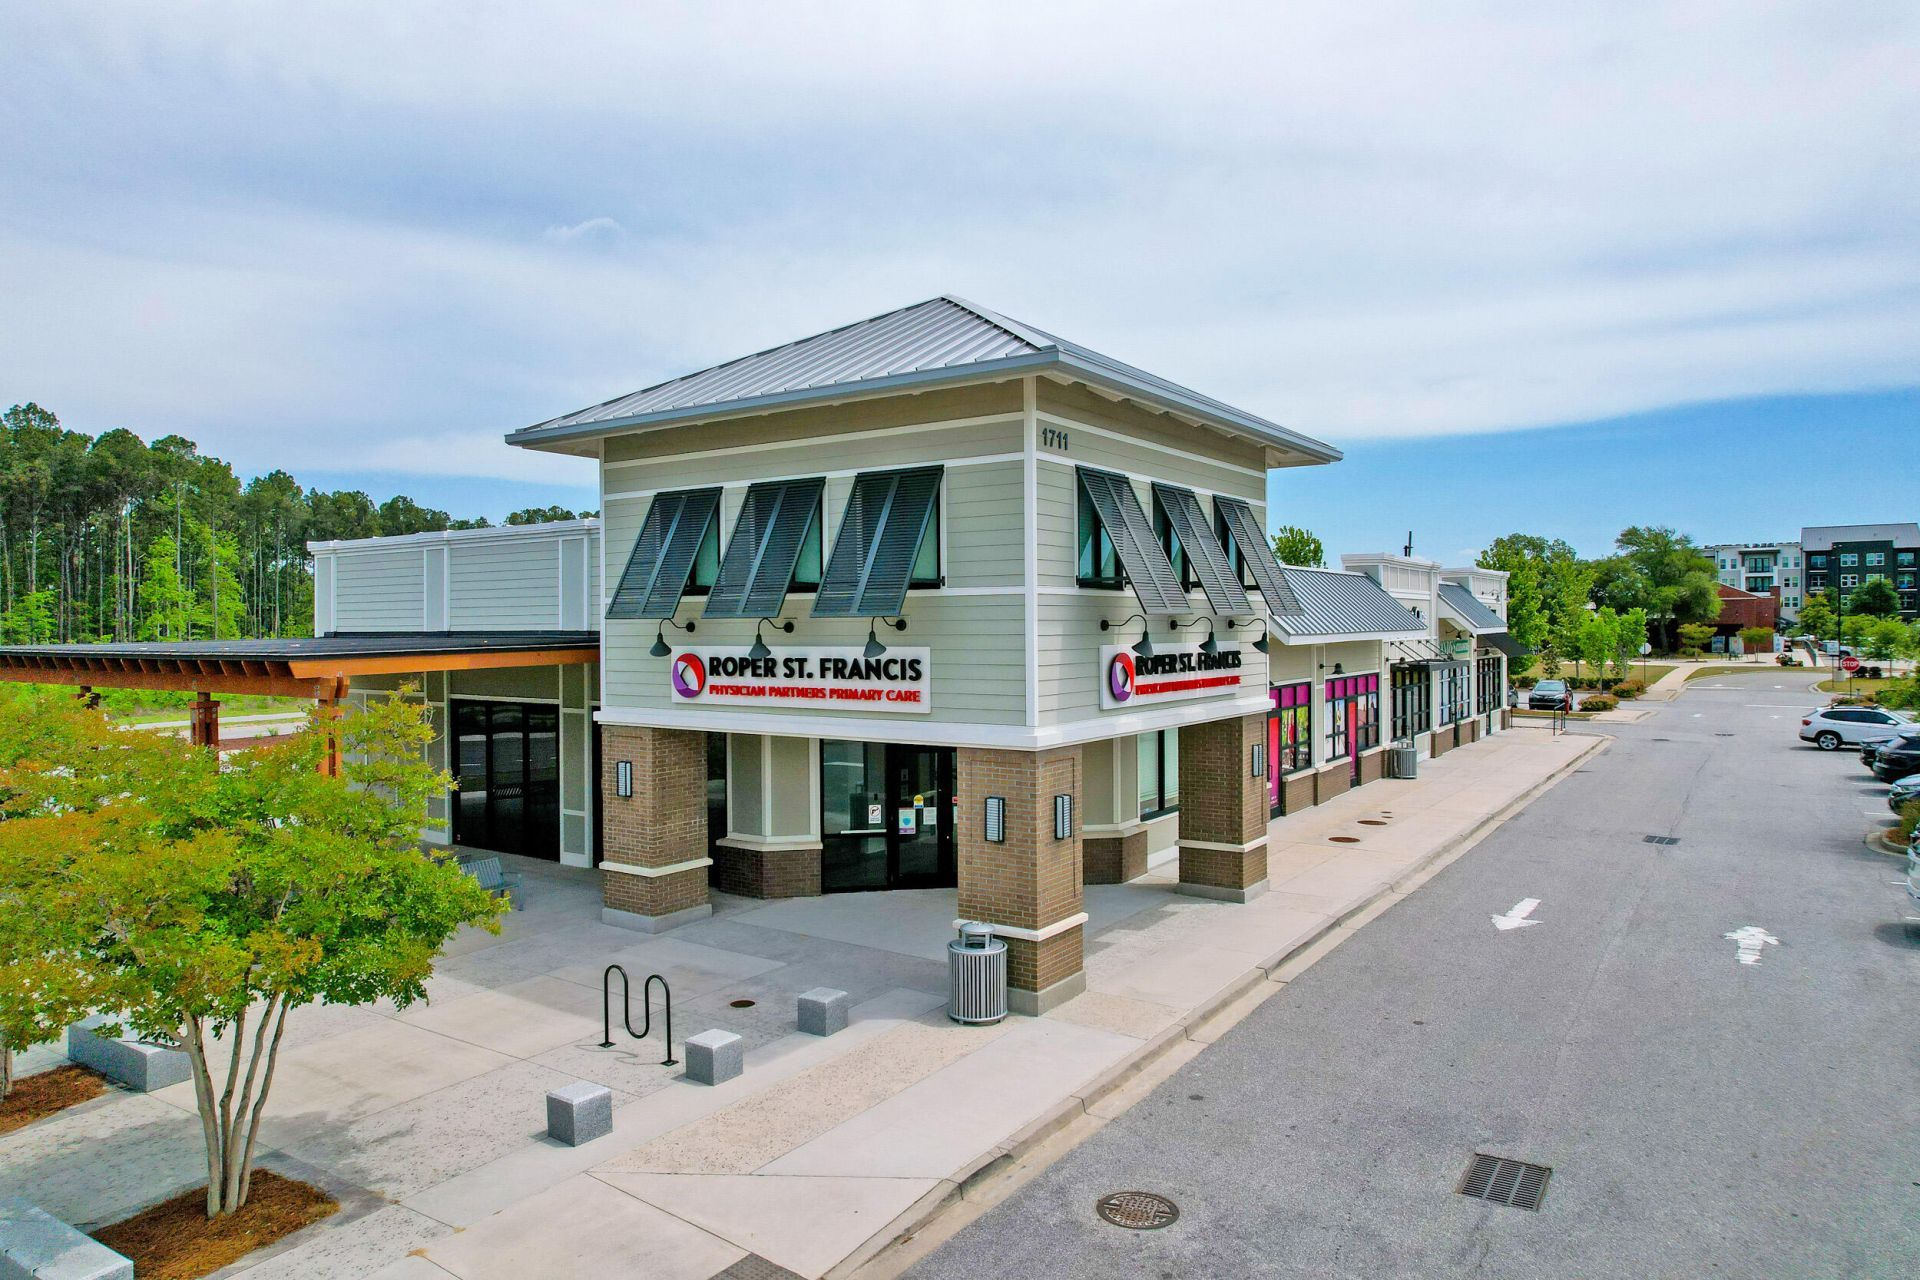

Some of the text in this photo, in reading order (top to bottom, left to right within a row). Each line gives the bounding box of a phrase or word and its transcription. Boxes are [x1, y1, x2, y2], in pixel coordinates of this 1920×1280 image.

[1042, 427, 1068, 450] 1711
[709, 656, 922, 682] ROPER ST. FRANCIS
[1135, 655, 1177, 676] ROPER
[708, 684, 921, 702] PHYSICIAN PARTNERS PRIMARY CARE
